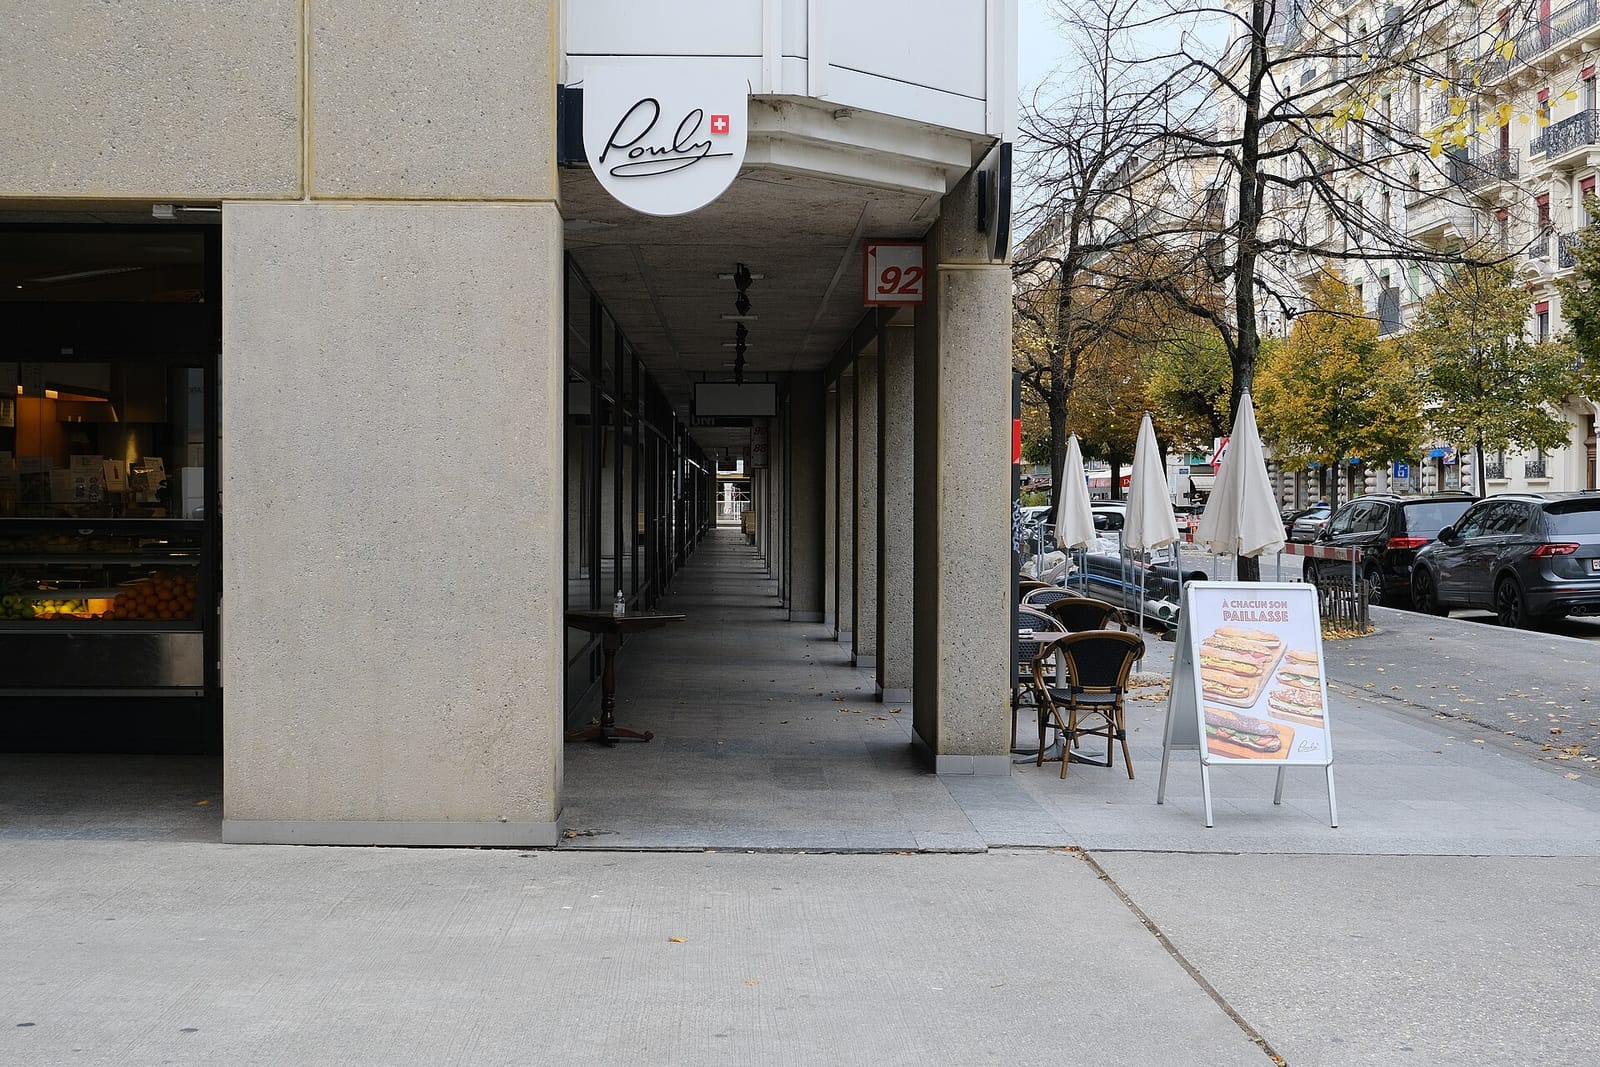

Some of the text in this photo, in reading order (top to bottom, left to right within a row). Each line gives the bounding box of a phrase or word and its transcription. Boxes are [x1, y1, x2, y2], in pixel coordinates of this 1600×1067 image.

[877, 266, 923, 294] 92
[1222, 598, 1288, 609] À CHACUN SON
[1223, 610, 1289, 622] PAILLASSE
